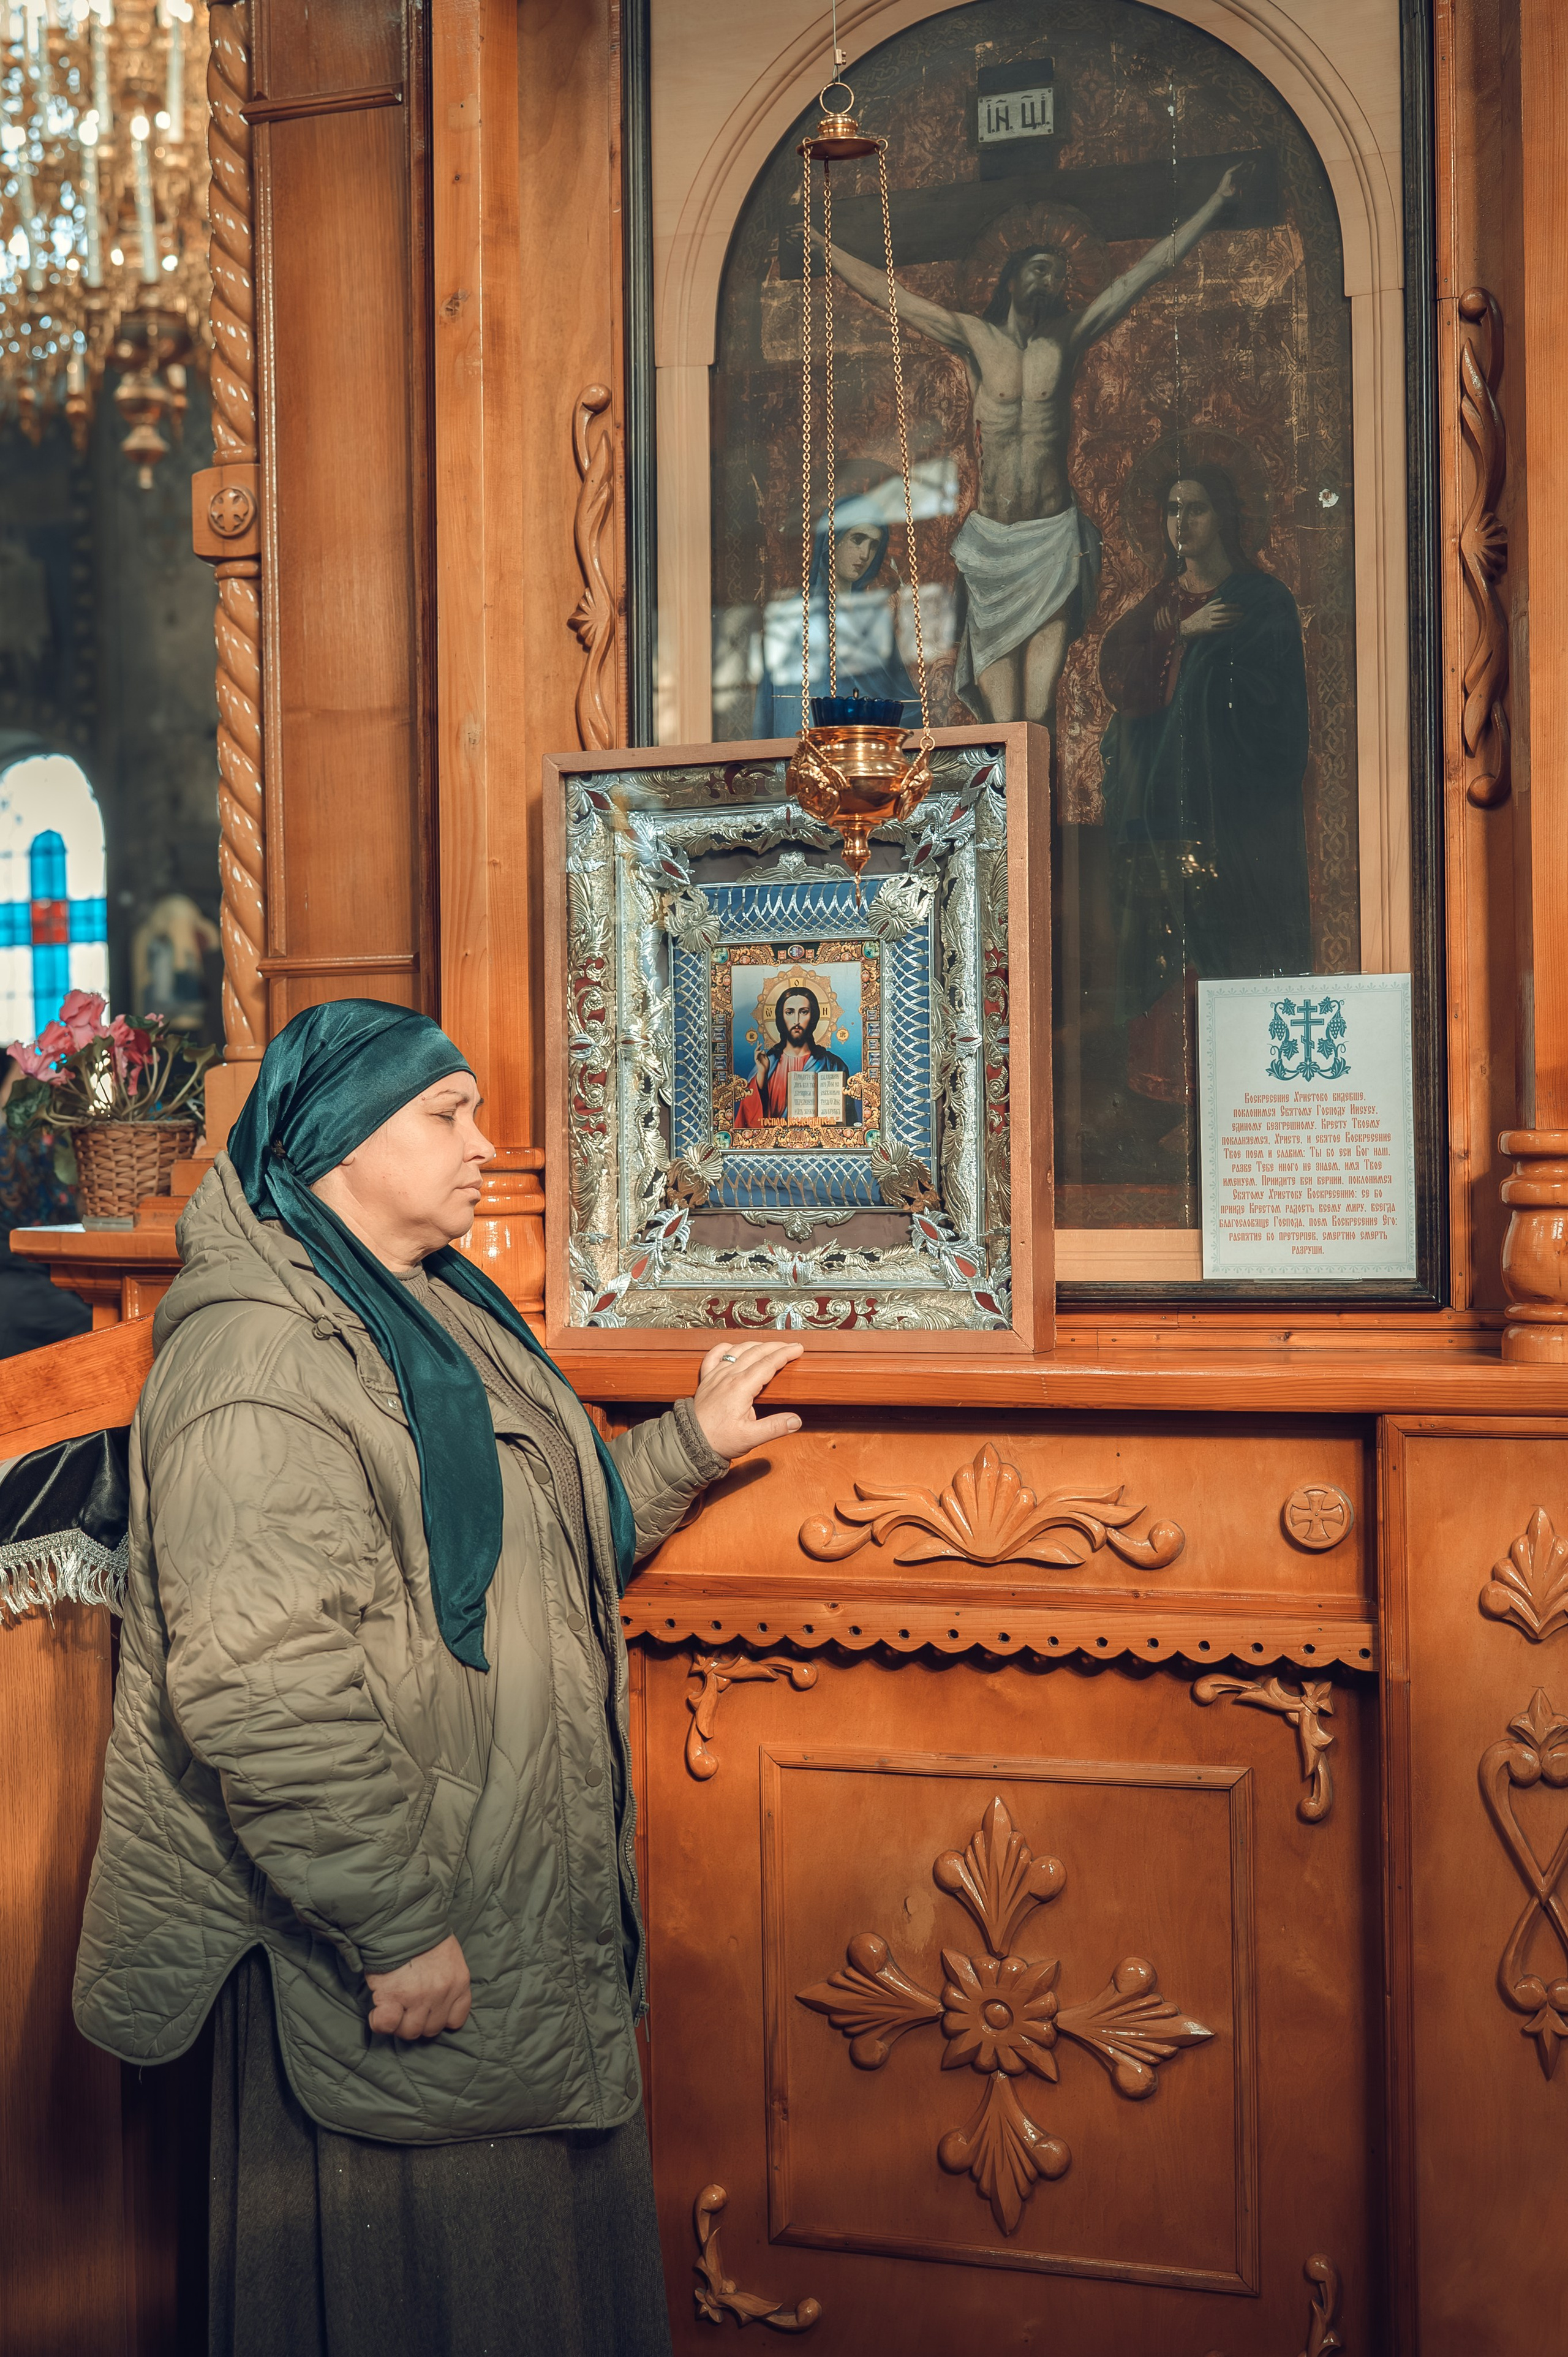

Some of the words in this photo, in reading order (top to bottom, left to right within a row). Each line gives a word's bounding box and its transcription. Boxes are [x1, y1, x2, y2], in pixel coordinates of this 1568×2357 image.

[1245, 1093, 1289, 1103] Воскресение
[1294, 1092, 1328, 1102] Христово
[1234, 1107, 1276, 1117] поклонимся
[1281, 1105, 1312, 1116] Святому
[1317, 1104, 1345, 1116] Господу
[1232, 1123, 1262, 1133] единому
[1321, 1118, 1347, 1129] Кресту
[1352, 1117, 1380, 1128] Твоему
[1316, 1134, 1341, 1144] святое
[1345, 1132, 1391, 1142] Воскресение
[1224, 1148, 1241, 1159] Твое
[1246, 1150, 1264, 1159] поем
[1310, 1146, 1322, 1157] Ты
[1327, 1148, 1334, 1157] бо
[1340, 1148, 1351, 1156] еси
[1356, 1145, 1369, 1156] Бог
[1232, 1164, 1252, 1172] разве
[1256, 1161, 1274, 1172] Тебе
[1303, 1163, 1311, 1171] не
[1345, 1161, 1360, 1171] имя
[1364, 1158, 1382, 1170] Твое
[1262, 1175, 1295, 1186] Приидите
[1300, 1177, 1313, 1185] вси
[1349, 1175, 1392, 1184] поклонимся
[1233, 1189, 1264, 1200] Святому
[1268, 1189, 1302, 1199] Христову
[1362, 1190, 1370, 1198] се
[1221, 1205, 1245, 1215] прииде
[1250, 1203, 1281, 1213] Крестом
[1286, 1204, 1314, 1214] радость
[1319, 1204, 1341, 1213] всему
[1371, 1203, 1395, 1213] всегда
[1219, 1218, 1269, 1229] благословяще
[1309, 1218, 1327, 1226] поем
[1332, 1215, 1378, 1226] Воскресение
[1229, 1232, 1262, 1242] распятие
[1267, 1232, 1275, 1241] бо
[1322, 1231, 1355, 1240] смертию
[1360, 1231, 1387, 1240] смерть
